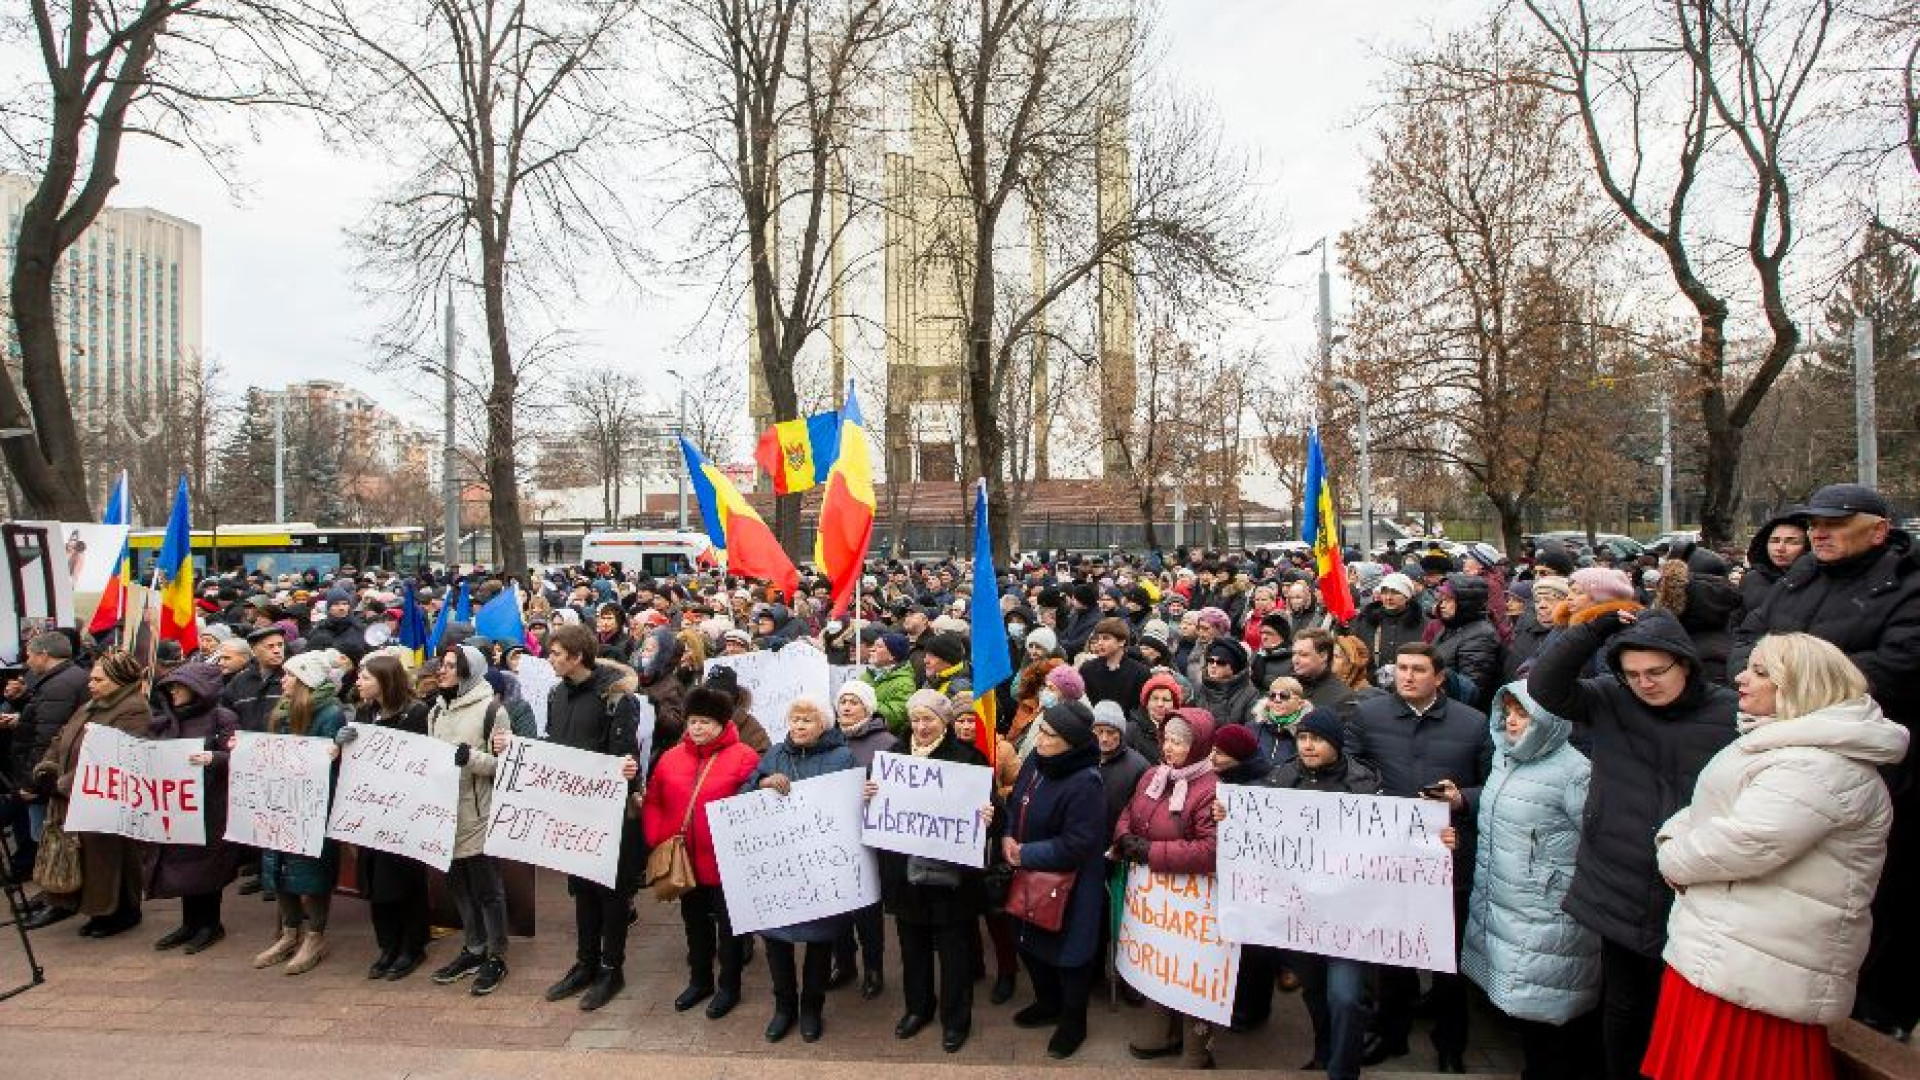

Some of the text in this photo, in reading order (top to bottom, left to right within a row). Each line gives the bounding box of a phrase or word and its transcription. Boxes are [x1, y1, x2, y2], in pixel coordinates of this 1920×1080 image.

[82, 764, 199, 812] ЦЕНЗУРЕ
[495, 739, 533, 793] НЕ
[881, 755, 943, 788] VREM
[1224, 789, 1283, 829] PAS
[1338, 798, 1429, 844] MAIA
[1222, 827, 1315, 873] SANDU
